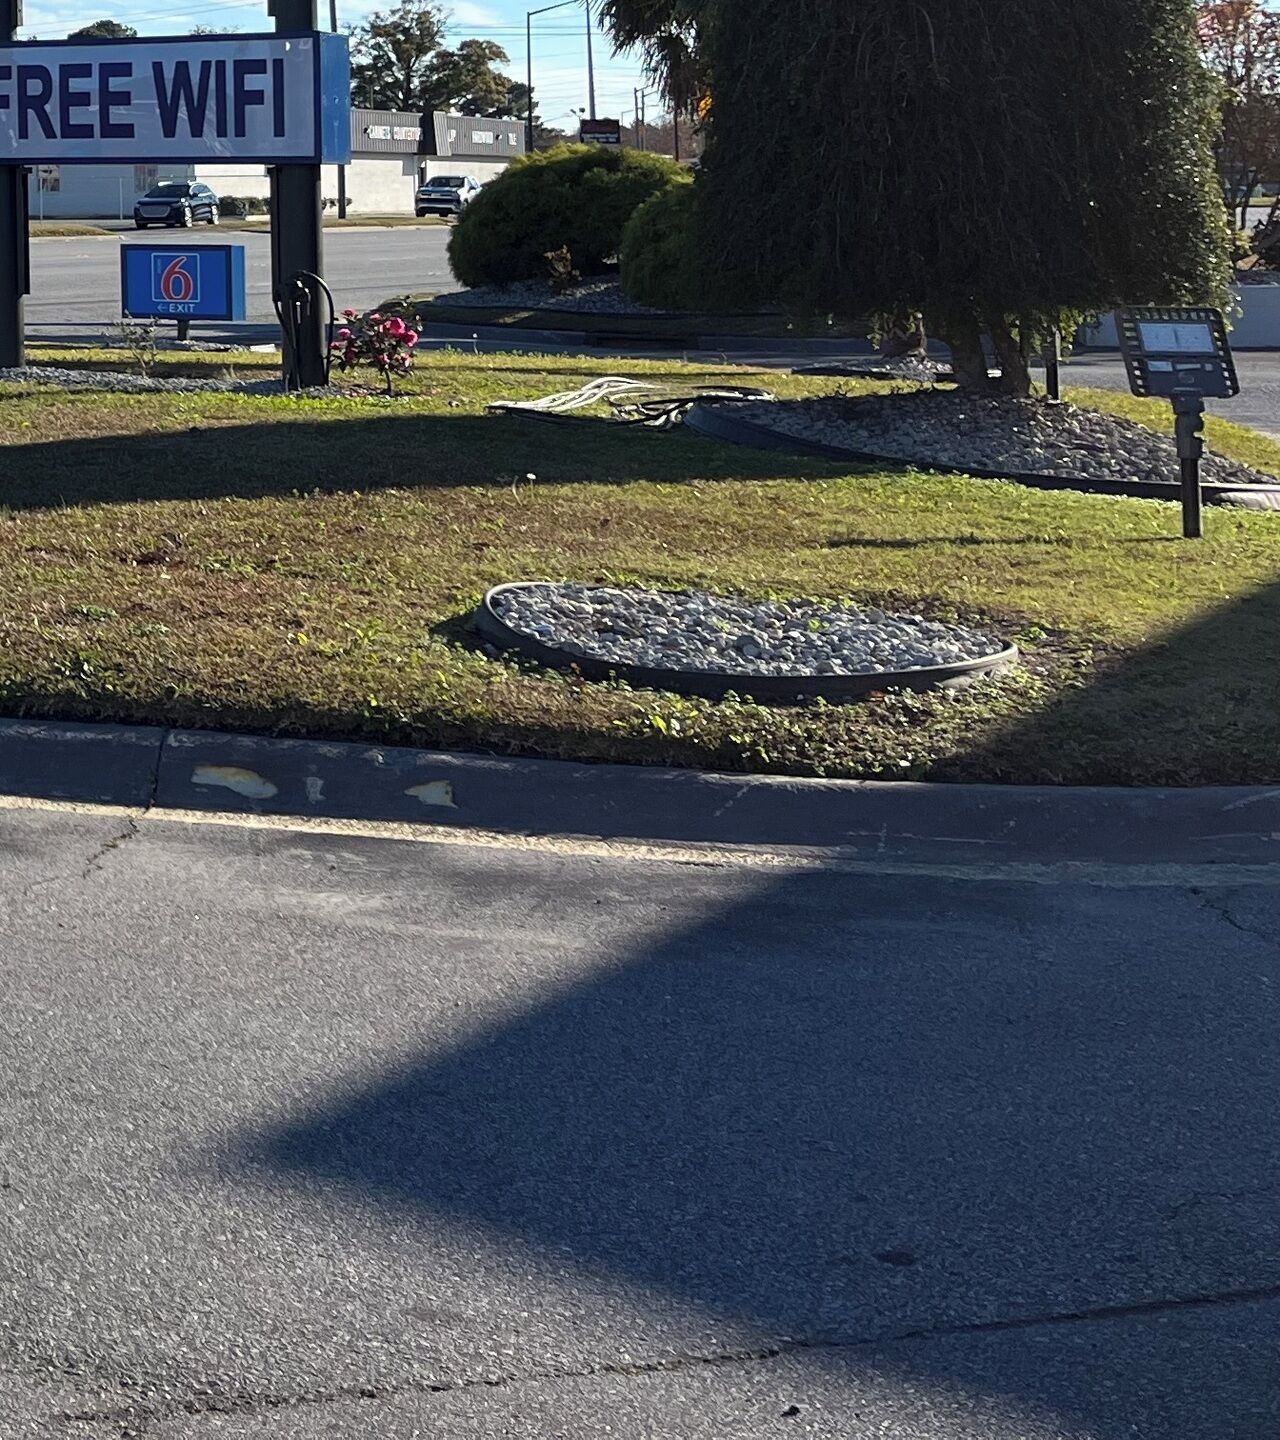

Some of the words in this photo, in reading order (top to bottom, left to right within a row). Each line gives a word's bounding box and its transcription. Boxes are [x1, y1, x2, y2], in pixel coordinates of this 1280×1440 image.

[151, 57, 286, 139] WIFI
[161, 256, 193, 302] 6
[168, 303, 196, 313] EXIT
